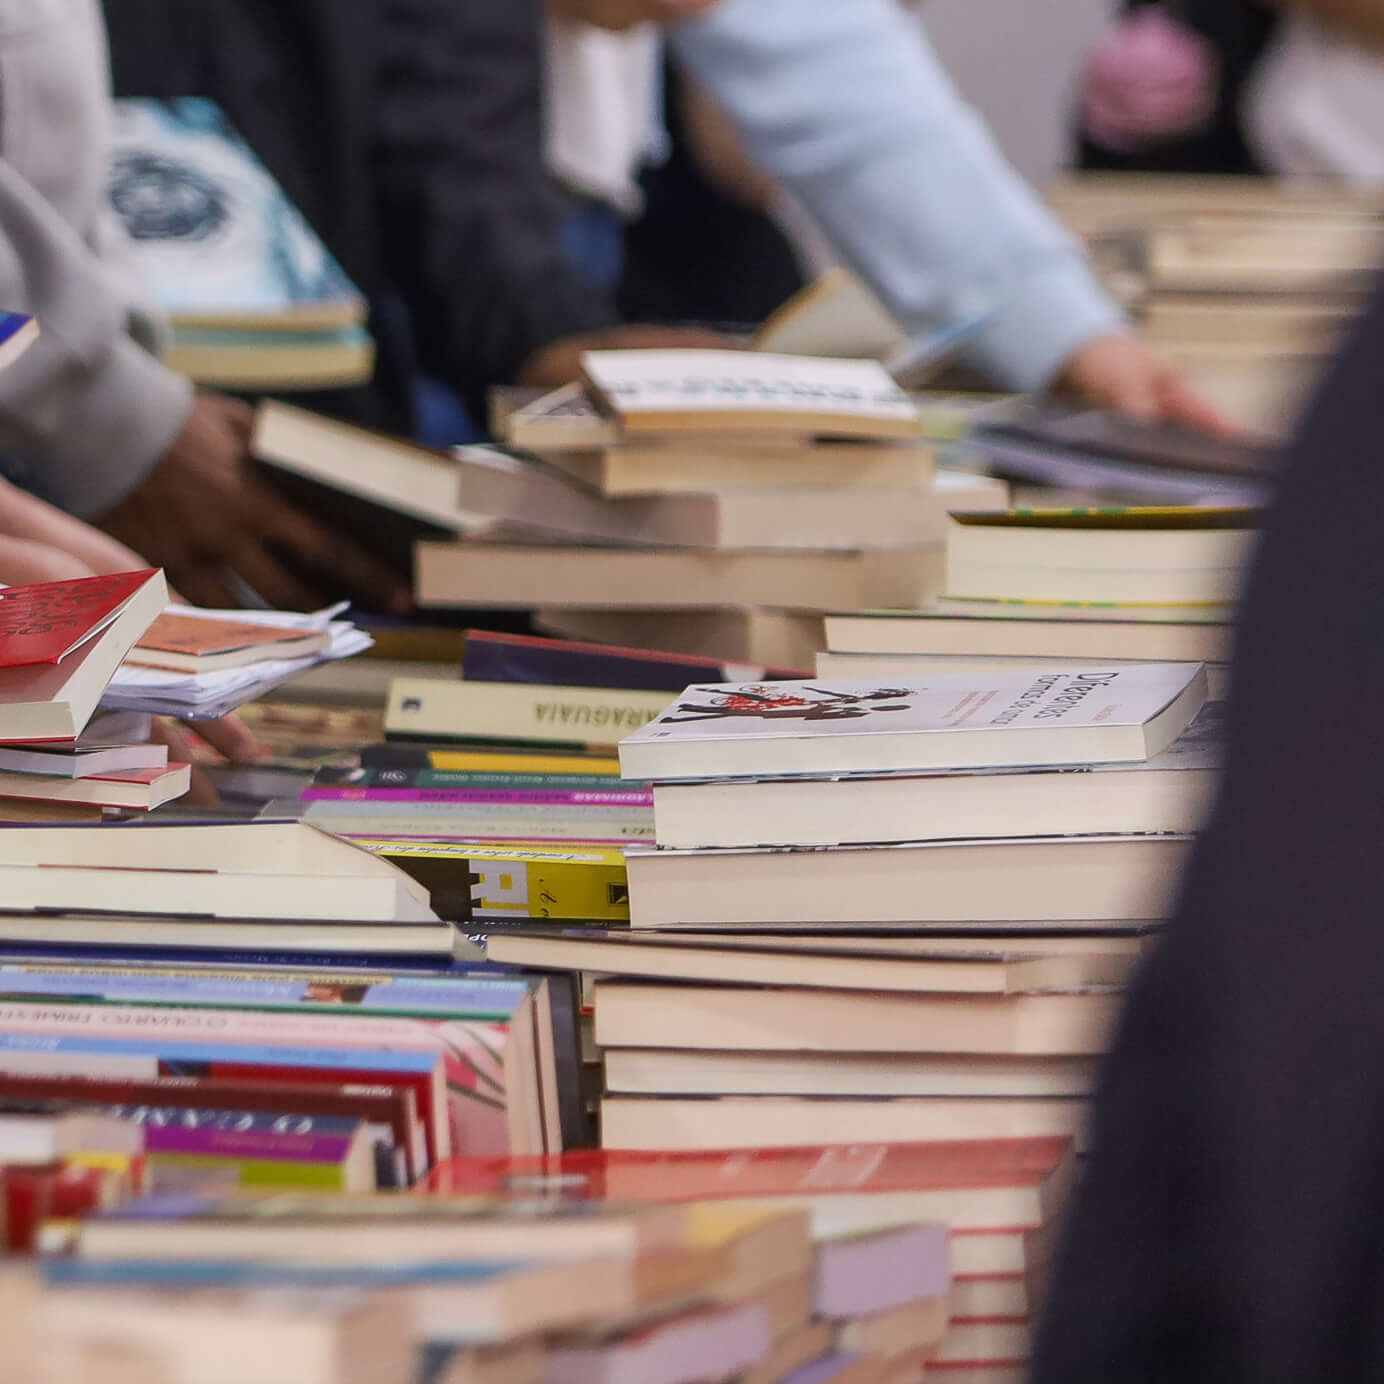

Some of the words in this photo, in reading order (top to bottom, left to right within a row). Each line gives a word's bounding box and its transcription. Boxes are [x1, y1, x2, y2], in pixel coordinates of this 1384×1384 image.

[1020, 674, 1070, 699] formas
[1033, 672, 1120, 719] Diferentes
[1009, 699, 1042, 709] de
